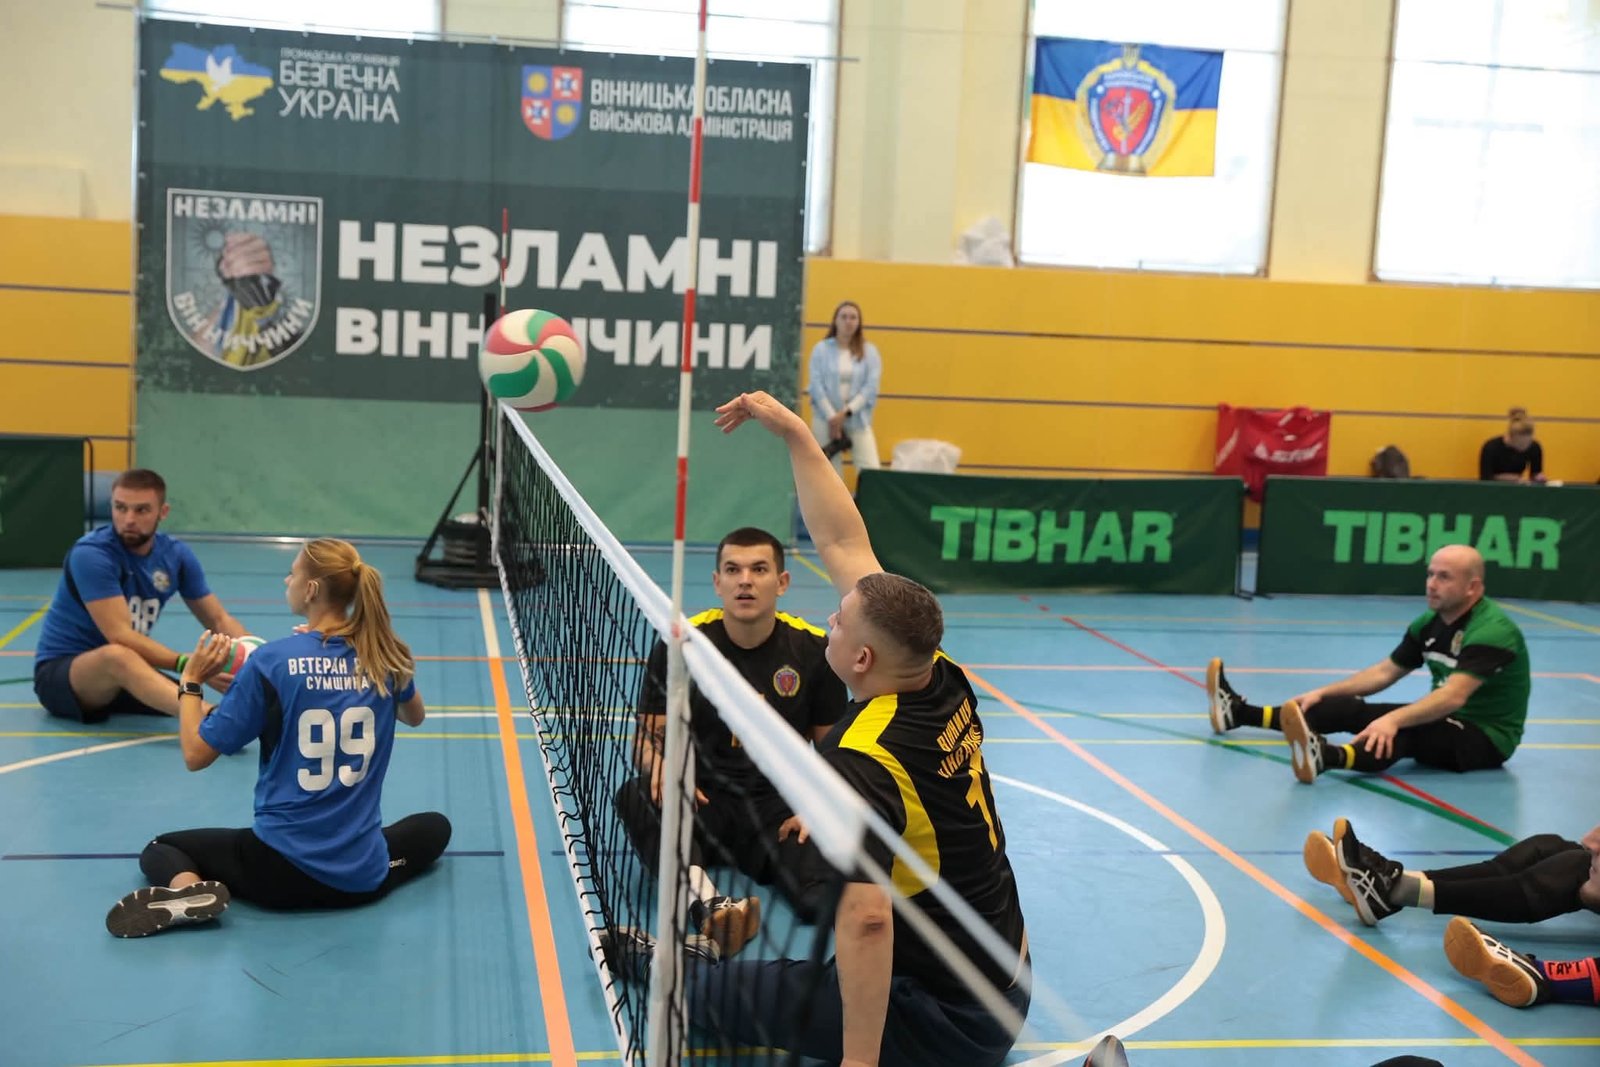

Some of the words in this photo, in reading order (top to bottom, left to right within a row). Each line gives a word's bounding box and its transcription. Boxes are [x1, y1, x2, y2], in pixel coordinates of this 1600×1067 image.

[280, 60, 400, 93] БЕЗПЕЧНА
[278, 86, 400, 124] УКРАЇНА
[705, 85, 793, 117] ОБЛАСНА
[590, 108, 675, 136] ВІЙСЬКОВА
[174, 195, 317, 225] НЕЗЛАМНІ
[338, 220, 778, 298] НЕЗЛАМНІ
[335, 307, 773, 370] ВІННЧИНИ
[930, 505, 1174, 564] TIBHAR
[1323, 510, 1562, 570] TIBHAR
[288, 657, 348, 675] ВЕТЕРАН
[297, 706, 376, 792] 99
